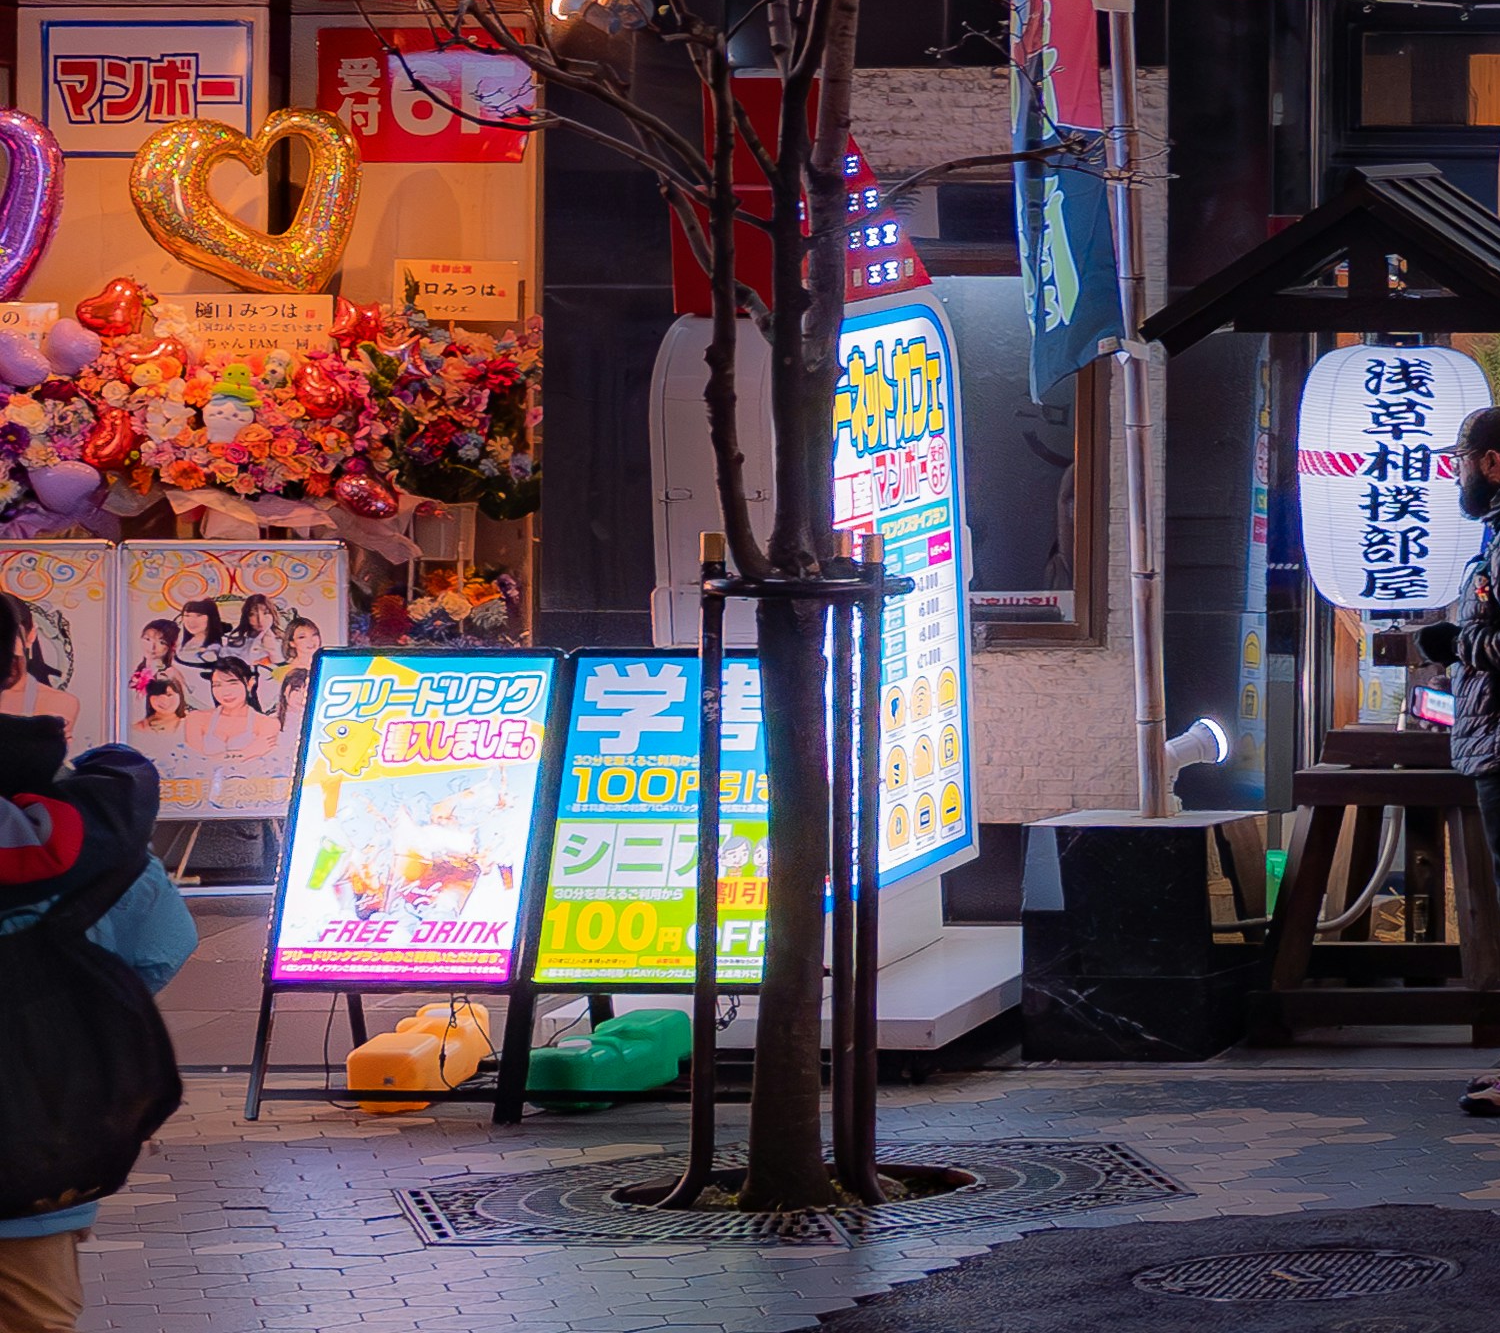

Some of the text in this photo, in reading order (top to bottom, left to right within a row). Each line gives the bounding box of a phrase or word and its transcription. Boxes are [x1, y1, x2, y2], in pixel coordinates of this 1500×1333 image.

[54, 54, 244, 124] マンボー
[337, 56, 382, 136] 受付
[408, 282, 497, 296] 口みつは
[249, 338, 278, 349] FAM
[1358, 357, 1434, 601] 浅草相撲部屋
[322, 674, 545, 717] フリードリンク
[382, 719, 537, 763] 導入しました。
[318, 919, 508, 945] FREE DRINK
